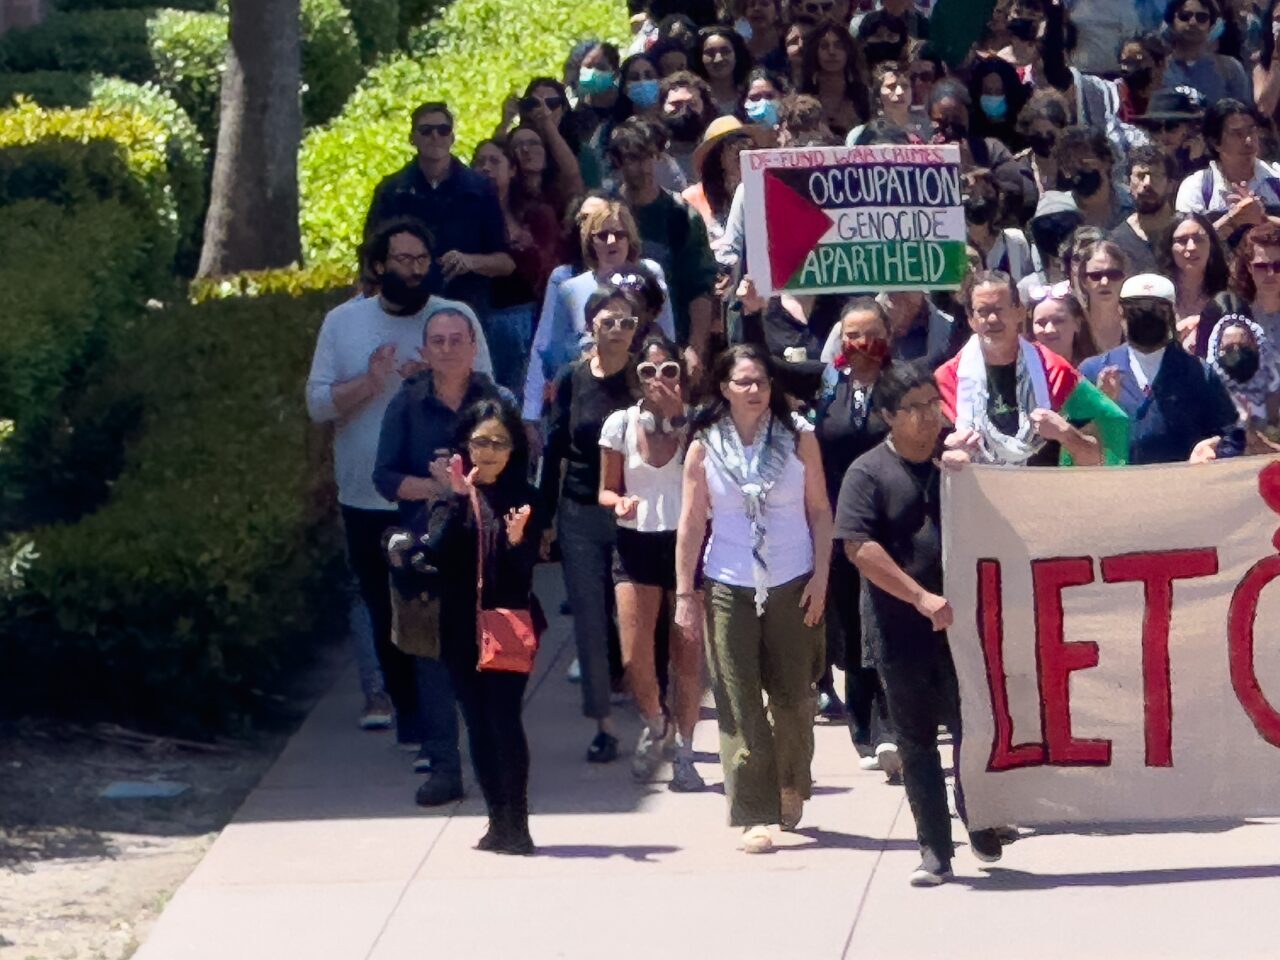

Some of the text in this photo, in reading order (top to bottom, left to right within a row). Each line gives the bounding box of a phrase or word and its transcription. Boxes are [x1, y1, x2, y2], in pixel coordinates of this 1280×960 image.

[835, 145, 877, 164] WAR
[881, 145, 945, 163] CRIMES
[808, 166, 962, 205] OCCUPATION
[837, 210, 949, 240] GENOCIDE
[800, 243, 945, 285] APARTHEID
[975, 546, 1219, 773] LET
